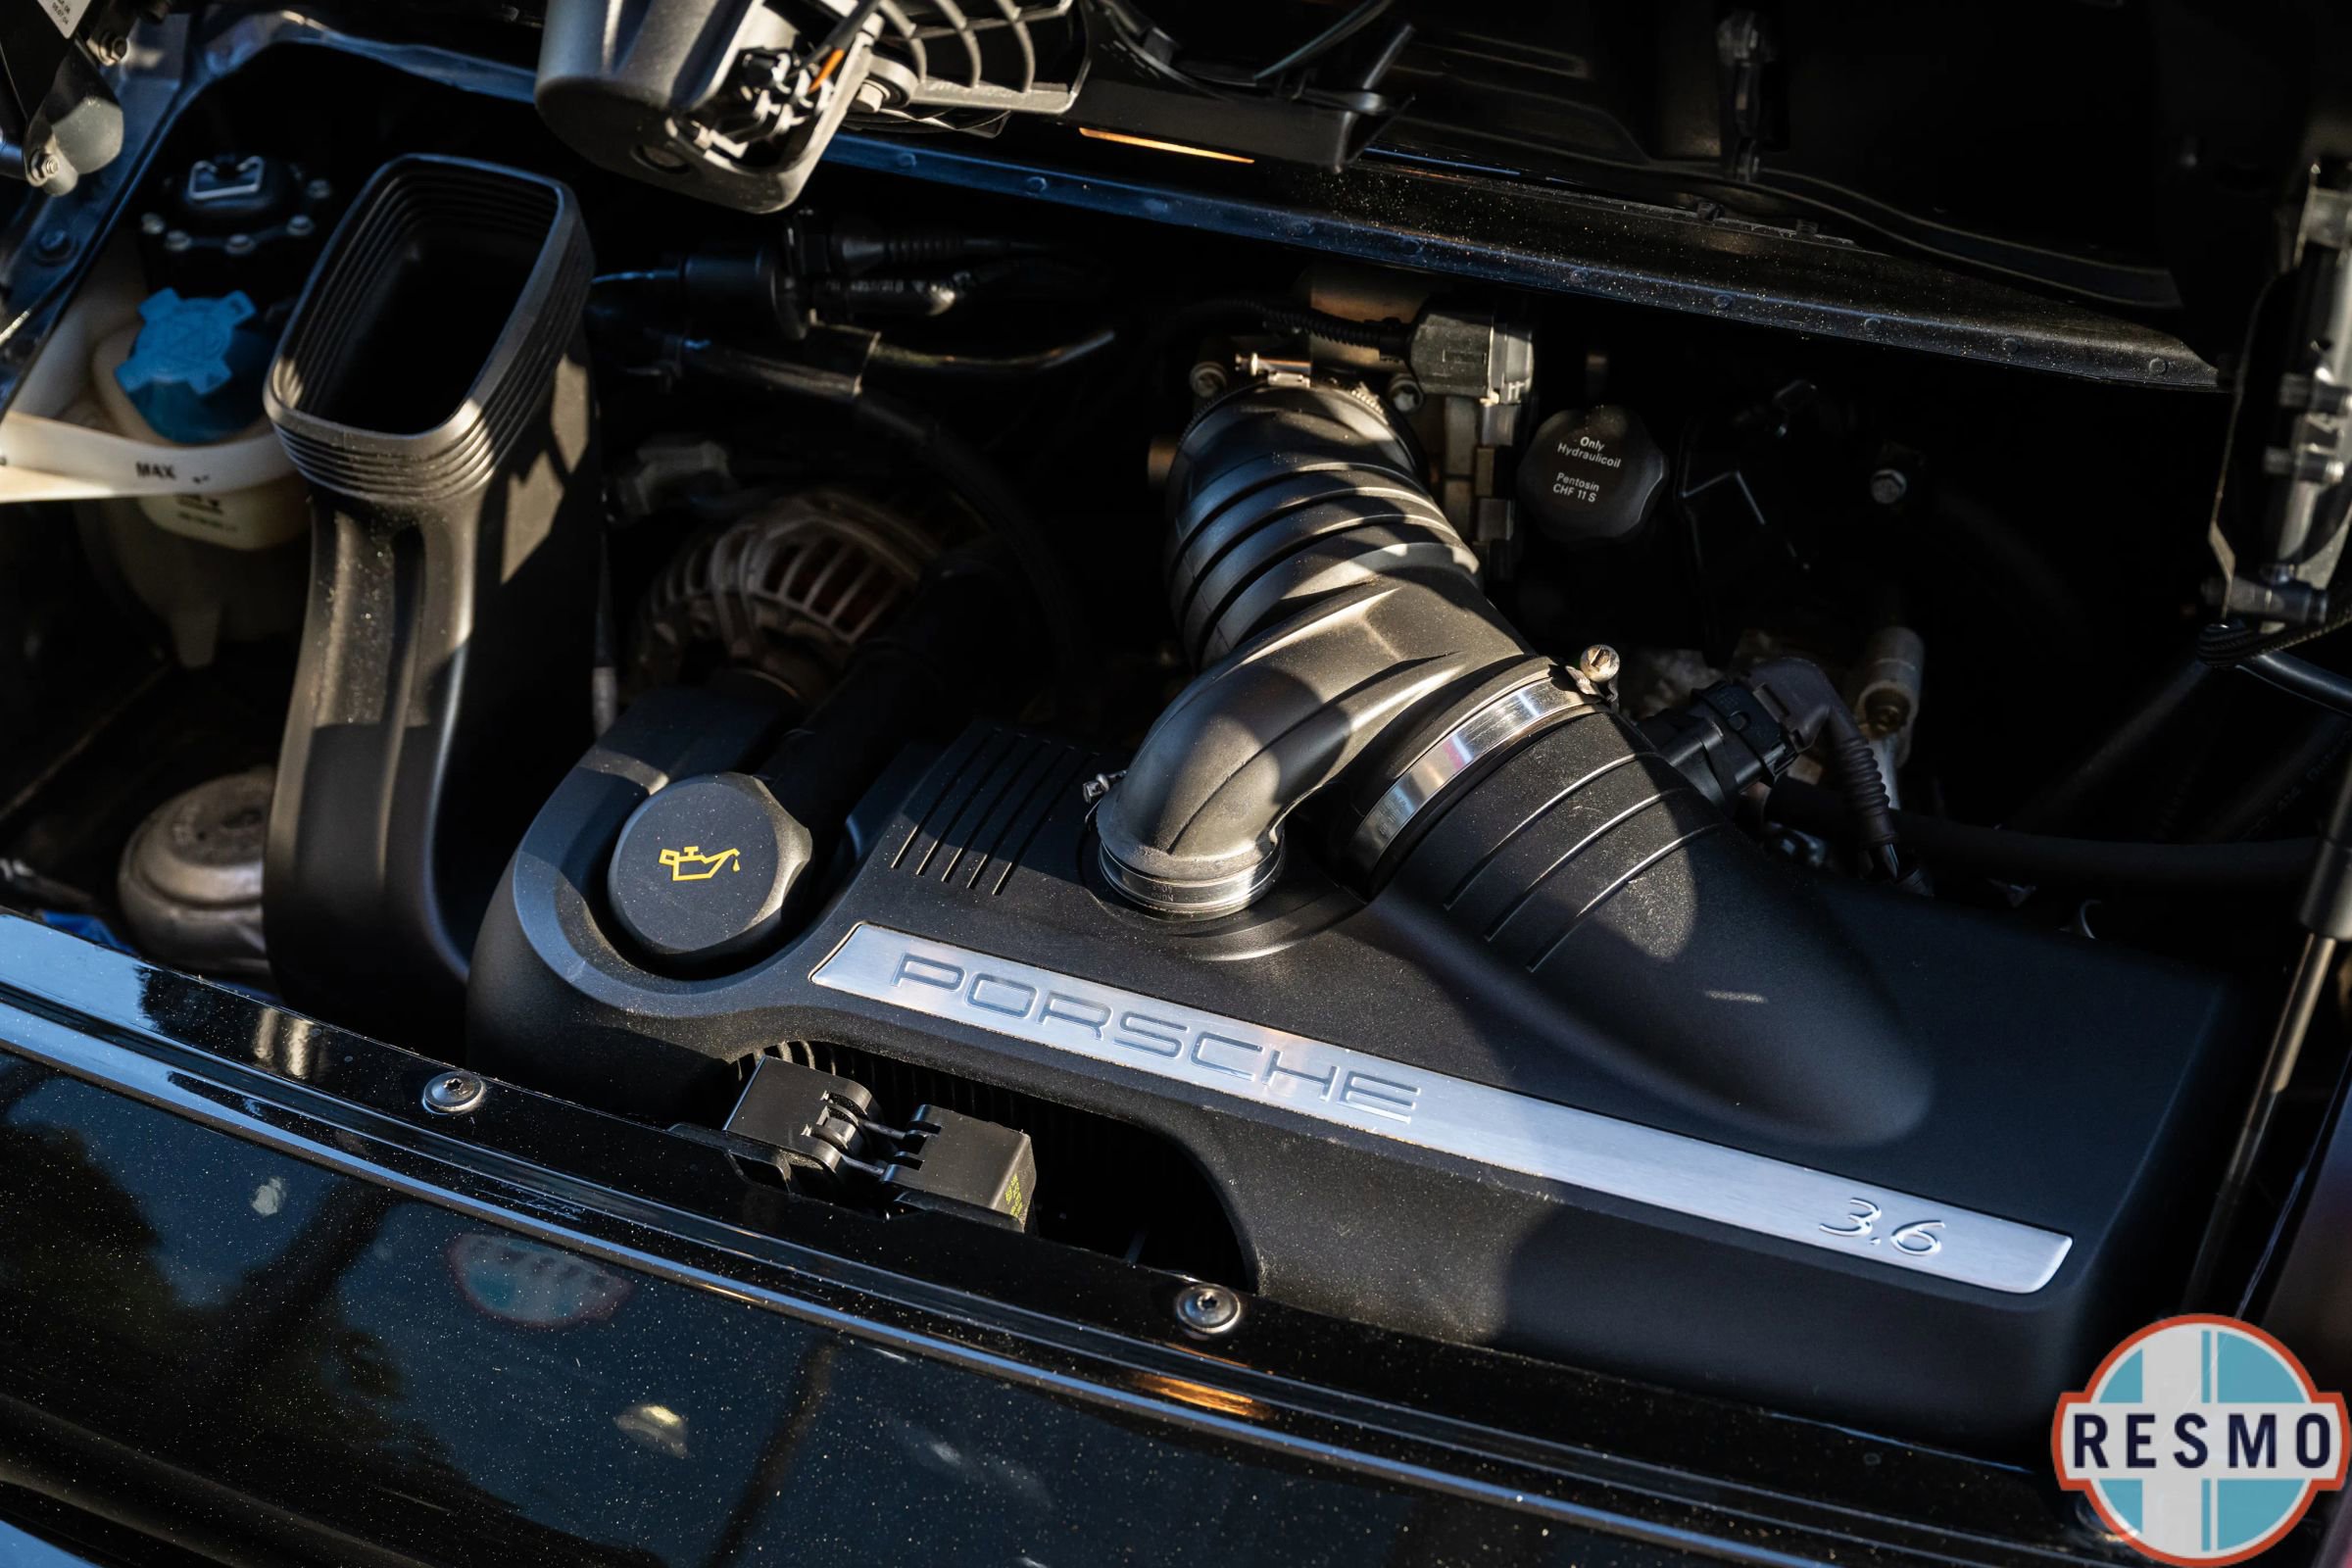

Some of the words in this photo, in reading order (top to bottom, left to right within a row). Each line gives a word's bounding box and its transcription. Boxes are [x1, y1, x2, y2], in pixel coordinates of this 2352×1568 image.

[1580, 436, 1605, 452] Only
[1556, 442, 1622, 468] Hydraulicoil
[135, 462, 176, 480] MAX
[1556, 471, 1600, 492] Pentosin
[1552, 483, 1575, 497] CHF
[1577, 489, 1587, 501] 11
[1588, 492, 1597, 503] S
[892, 953, 1421, 1125] PORSCHE
[1819, 1197, 1945, 1257] 3.6
